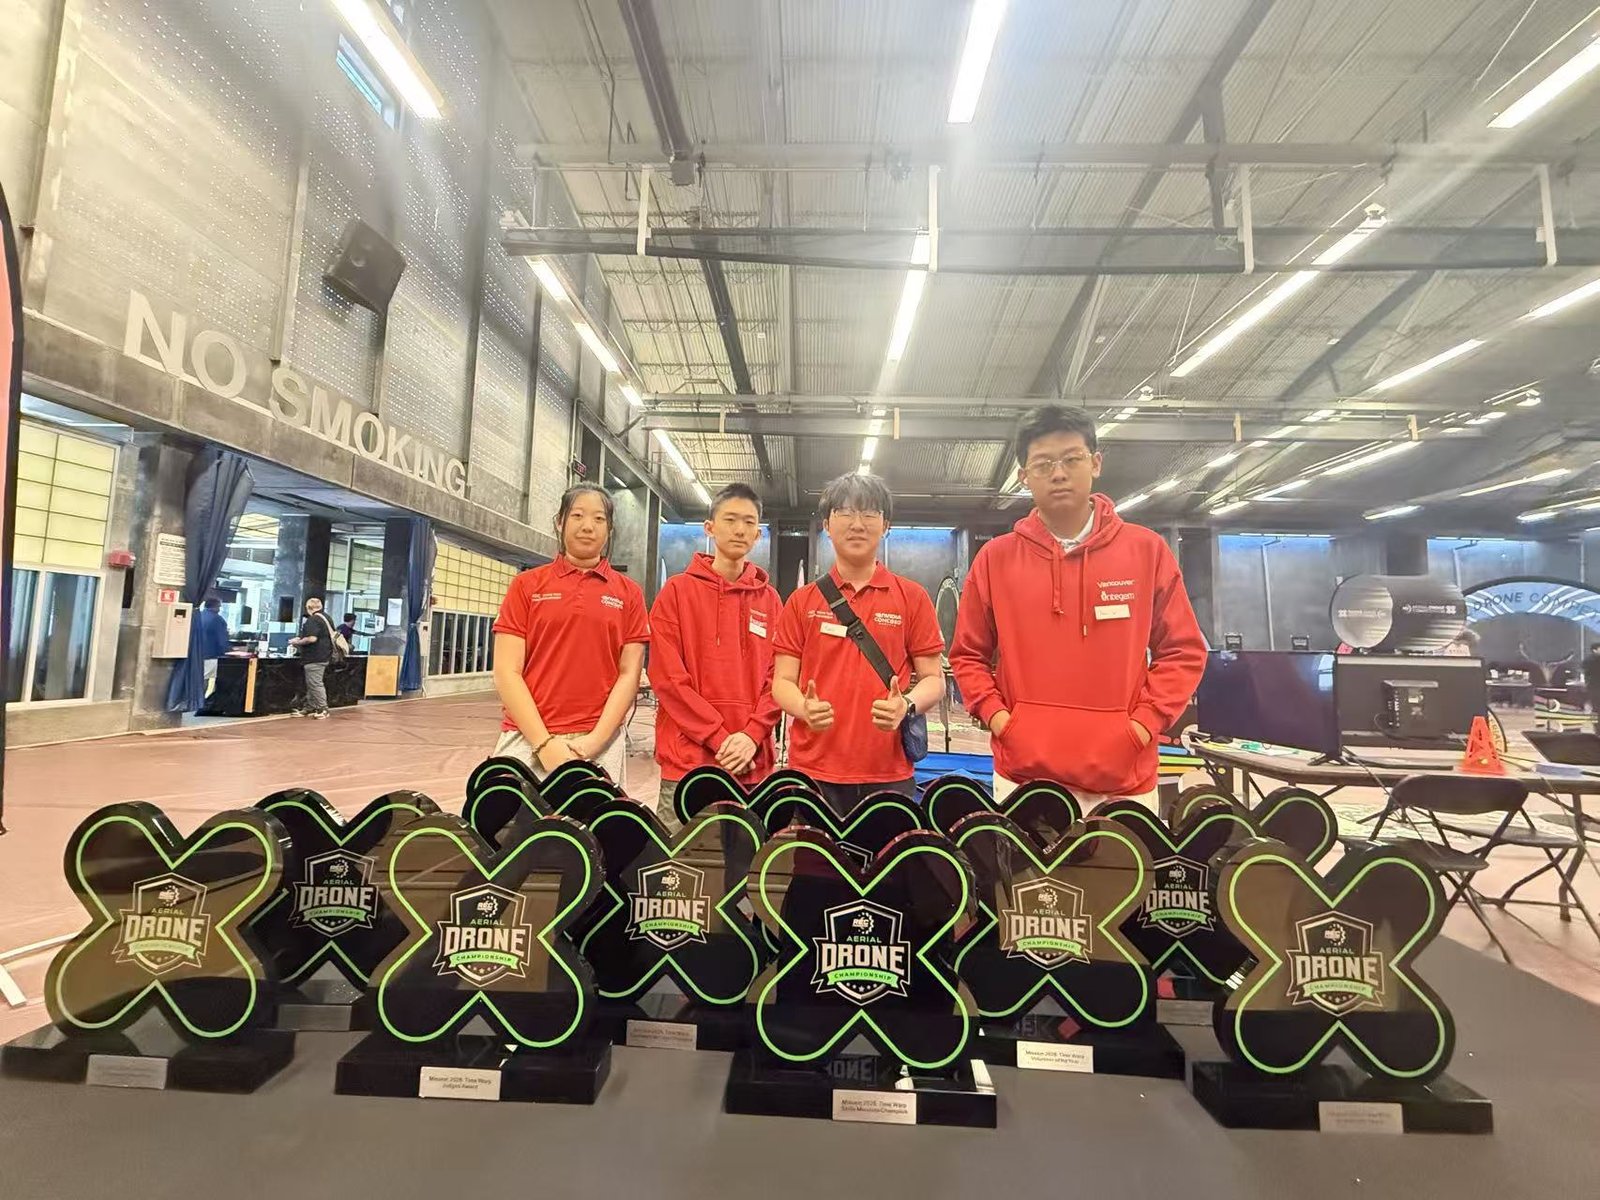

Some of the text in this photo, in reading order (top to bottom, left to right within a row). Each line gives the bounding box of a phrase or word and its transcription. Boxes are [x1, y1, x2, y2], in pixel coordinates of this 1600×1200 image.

[123, 289, 467, 499] NO SMOKING
[1473, 592, 1523, 611] DRONE
[299, 886, 373, 912] DRONE
[634, 897, 706, 925] DRONE
[1145, 890, 1211, 915] DRONE
[123, 915, 205, 947] DRONE
[443, 926, 526, 957] DRONE
[1010, 915, 1087, 945] DRONE
[821, 943, 905, 976] DRONE
[1295, 955, 1379, 986] DRONE
[834, 971, 892, 980] CHAMPIONSHIP
